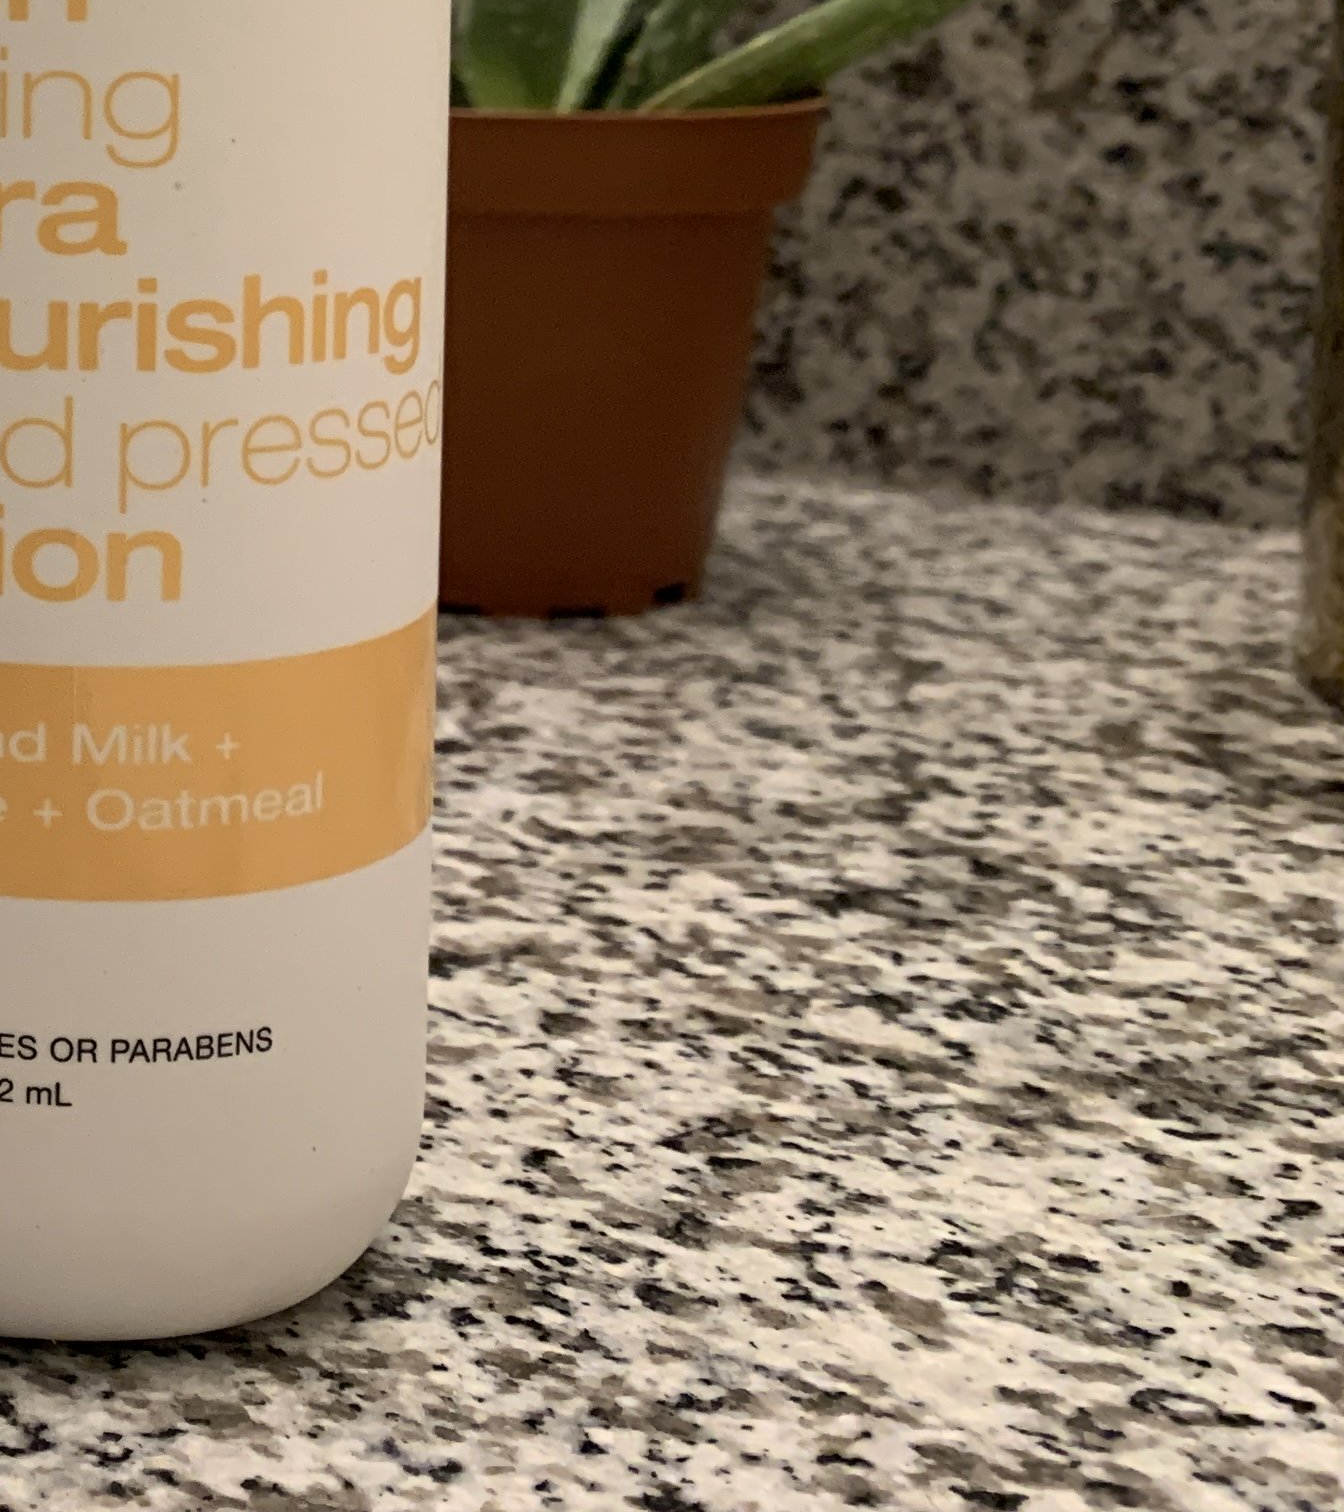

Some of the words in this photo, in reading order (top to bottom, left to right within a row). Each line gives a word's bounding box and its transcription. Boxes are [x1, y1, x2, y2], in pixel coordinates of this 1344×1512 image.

[70, 723, 193, 766] Milk
[85, 771, 325, 833] Oatmeal
[49, 1037, 99, 1064] OR
[109, 1026, 274, 1065] PARABENS
[25, 1082, 73, 1108] mL
